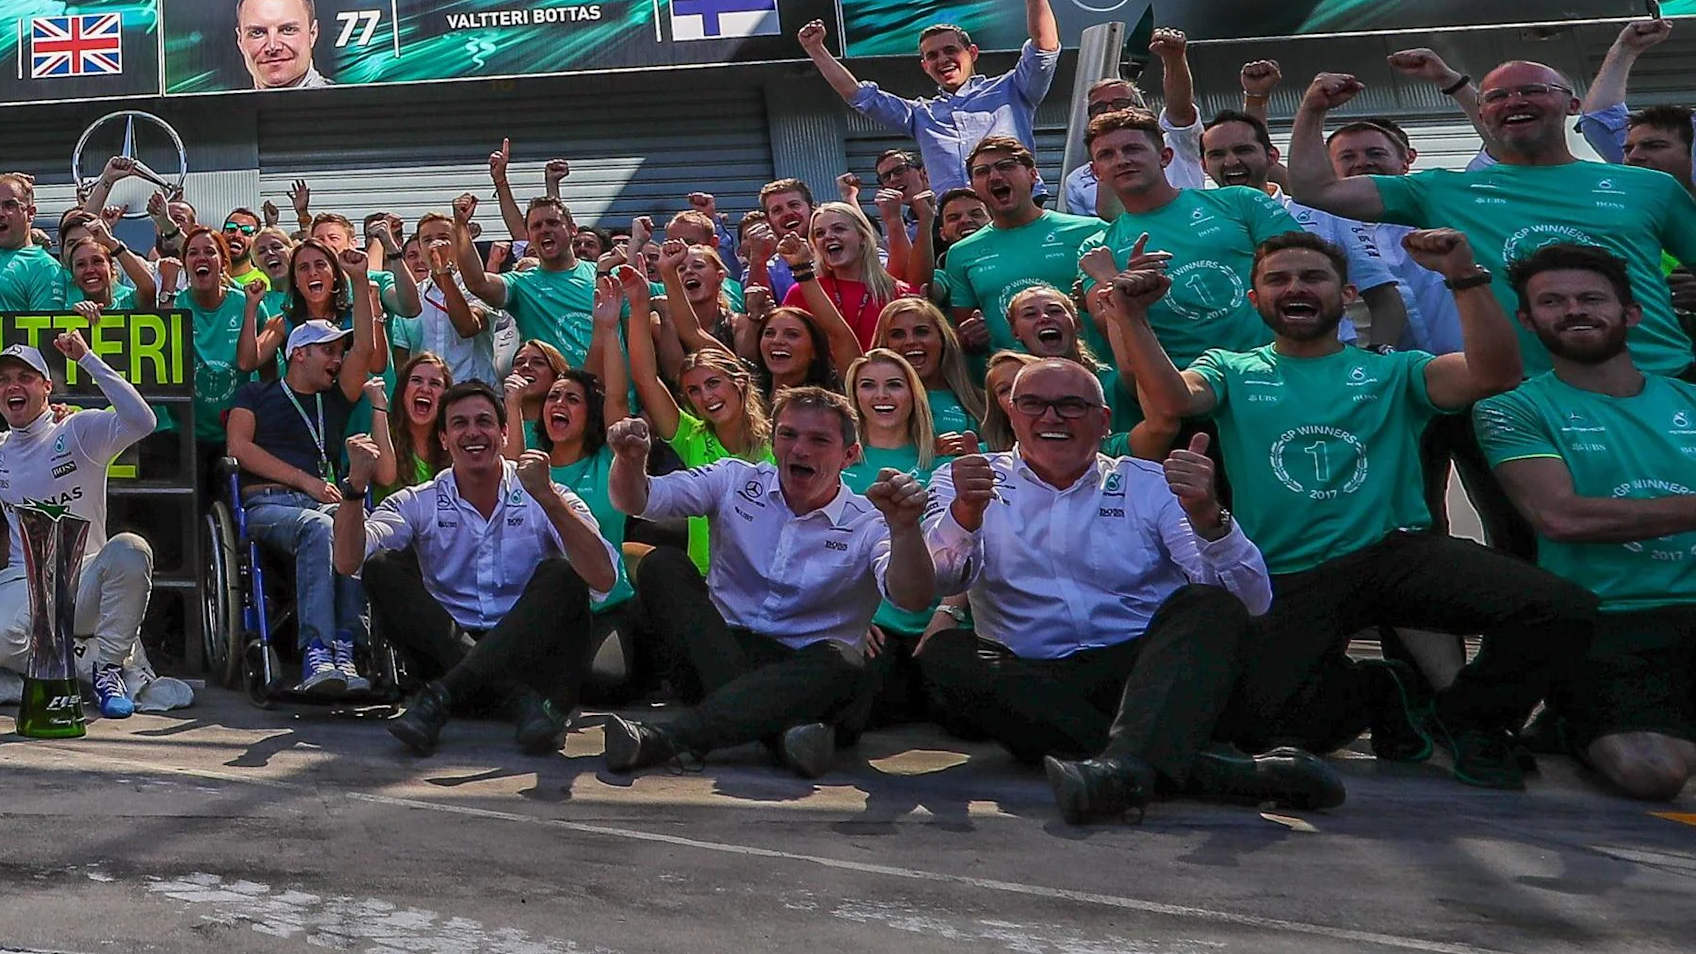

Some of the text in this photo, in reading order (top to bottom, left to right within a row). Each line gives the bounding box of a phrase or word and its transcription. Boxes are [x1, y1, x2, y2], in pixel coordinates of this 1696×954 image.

[445, 5, 602, 31] VALTTERI BOTTAS
[335, 9, 382, 47] 77
[1514, 223, 1592, 244] GP WINNERS
[1173, 259, 1219, 276] WINNERS
[1184, 273, 1215, 306] 1
[1205, 307, 1229, 321] 2017
[1258, 394, 1278, 402] UBS
[1280, 425, 1358, 444] GP WINNERS
[53, 462, 76, 477] BOSS
[1304, 440, 1330, 482] 1
[1309, 489, 1338, 500] 2017
[1613, 482, 1631, 497] GP
[1651, 549, 1683, 562] 2017
